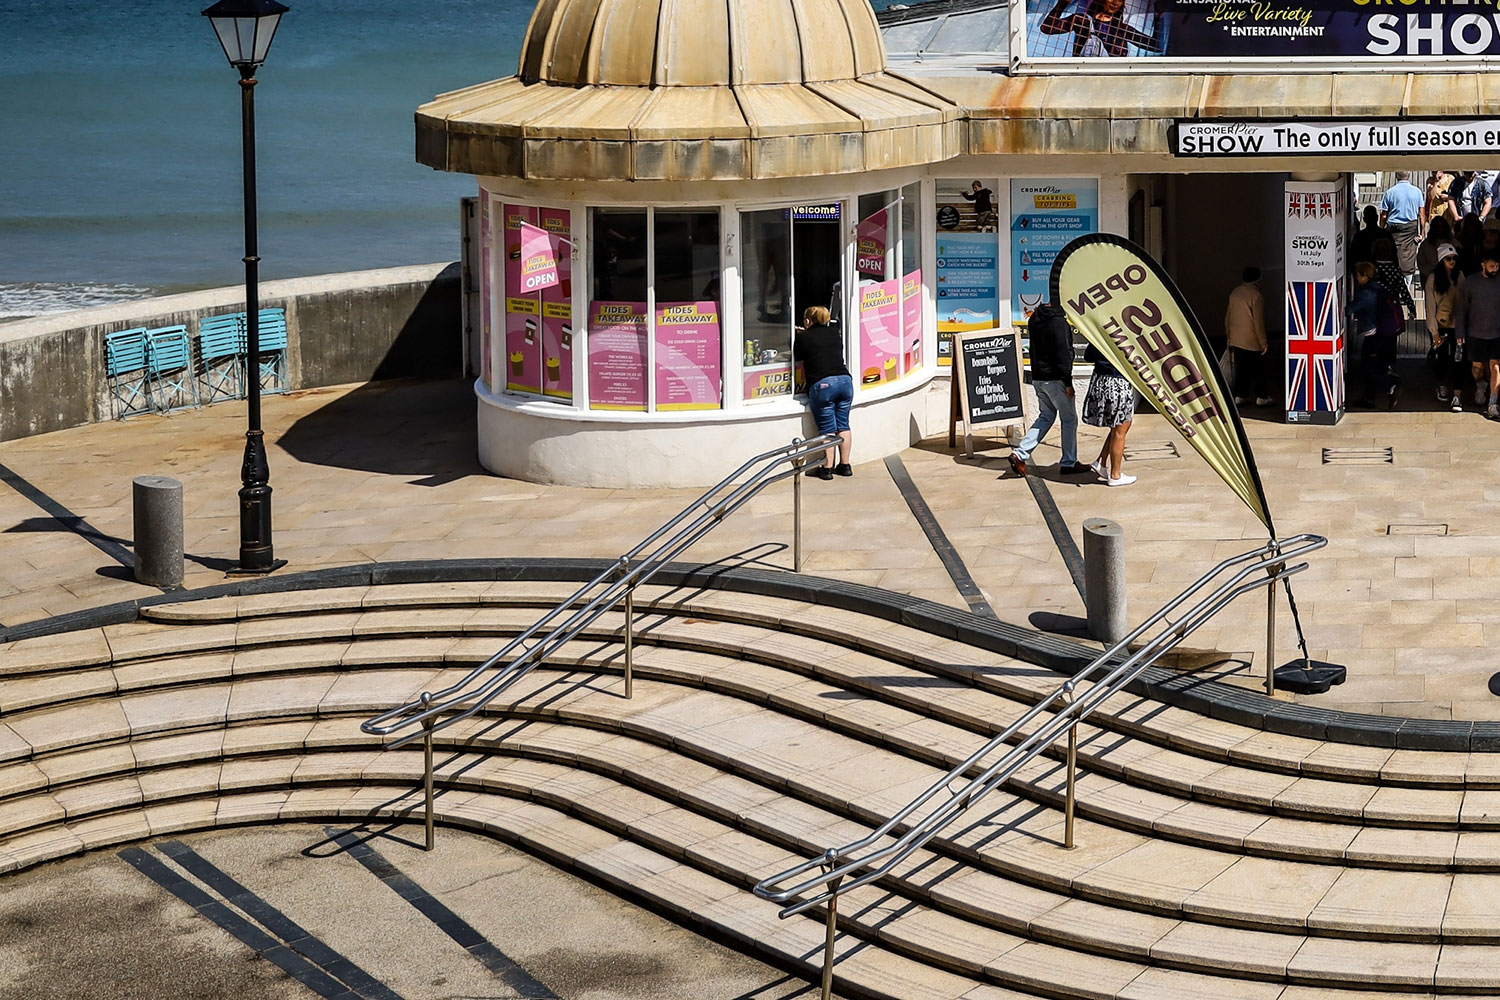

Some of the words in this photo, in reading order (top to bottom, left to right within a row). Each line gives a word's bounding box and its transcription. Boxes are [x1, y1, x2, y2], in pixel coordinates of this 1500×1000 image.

[1206, 2, 1247, 23] Live
[1250, 1, 1313, 27] Variety
[1231, 26, 1325, 37] ENTERTAINMENT
[1189, 126, 1235, 135] CROMER
[1231, 121, 1258, 135] Pier
[1273, 128, 1311, 148] The
[1317, 127, 1362, 150] only
[1368, 126, 1400, 147] full
[1407, 129, 1478, 147] season
[1182, 135, 1265, 153] SHOW
[1292, 240, 1329, 249] SHOW
[528, 257, 543, 265] TIDES
[858, 258, 882, 271] OPEN
[525, 261, 556, 273] TAKEAWAY
[526, 272, 556, 288] OPEN
[865, 290, 882, 300] TIDES
[862, 296, 894, 309] TAKEAWAY
[604, 306, 628, 314] TIDES
[598, 314, 648, 323] TAKEAWAY
[661, 315, 713, 323] TAKEAWAY
[964, 340, 994, 350] CROMER
[987, 365, 1006, 376] Burgers
[979, 376, 992, 385] Fries
[976, 386, 986, 395] Cold
[986, 384, 1004, 393] Drinks
[984, 395, 993, 404] Hot
[993, 392, 1009, 402] Drinks
